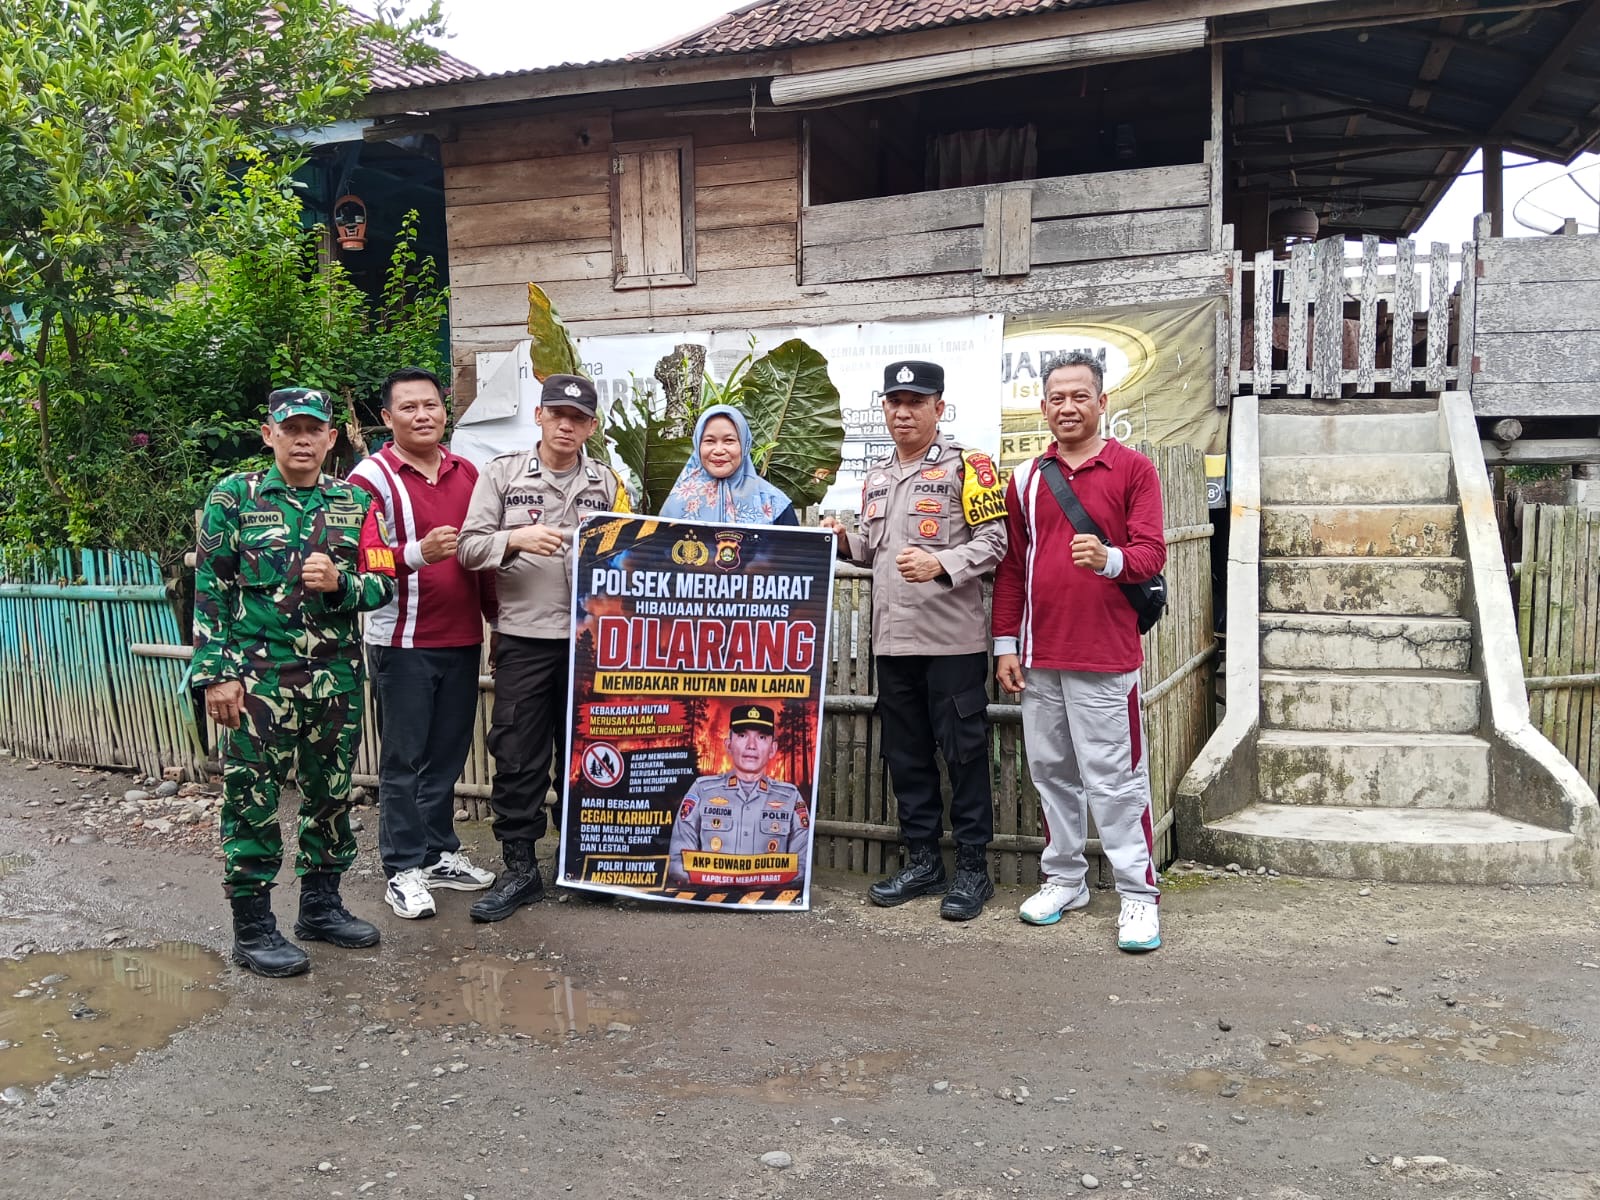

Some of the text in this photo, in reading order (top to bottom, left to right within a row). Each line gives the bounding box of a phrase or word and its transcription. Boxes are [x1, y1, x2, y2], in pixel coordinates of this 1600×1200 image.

[1013, 382, 1040, 399] Ist
[842, 408, 887, 426] Septe
[913, 484, 949, 495] POLRI
[968, 500, 1008, 522] BINM
[329, 516, 348, 525] TNI
[591, 568, 814, 601] POLSEK MERAPI BARAT
[635, 601, 789, 618] HIBAUAAN KAMTIBMAS
[597, 616, 817, 673] DILARANG
[601, 675, 805, 694] MEMBAKAR HUTAN DAN LAHAN
[590, 704, 670, 715] KEBAKARAN HUTAN
[590, 716, 628, 726] MERUSAK
[589, 724, 684, 736] MENGANCAM MASA DEPAN!
[629, 769, 659, 777] MERUSAK
[629, 777, 678, 786] DAN MERUGIKAN
[581, 798, 650, 809] MARI BERSAMA
[580, 809, 673, 825] CEGAH KARHUTLA
[762, 811, 789, 820] POLRI
[580, 824, 661, 835] DEMI MERAPI BARAT
[580, 834, 600, 842] YANG
[627, 835, 653, 845] SEHAT
[579, 843, 630, 853] DAN LESTARI
[597, 861, 656, 872] POLRI UNTUK
[692, 856, 790, 871] AKP EDWARD GULTOM
[590, 871, 658, 885] MASYARAKAT
[701, 874, 781, 884] KAPOLSEK MERAPI BARAT
